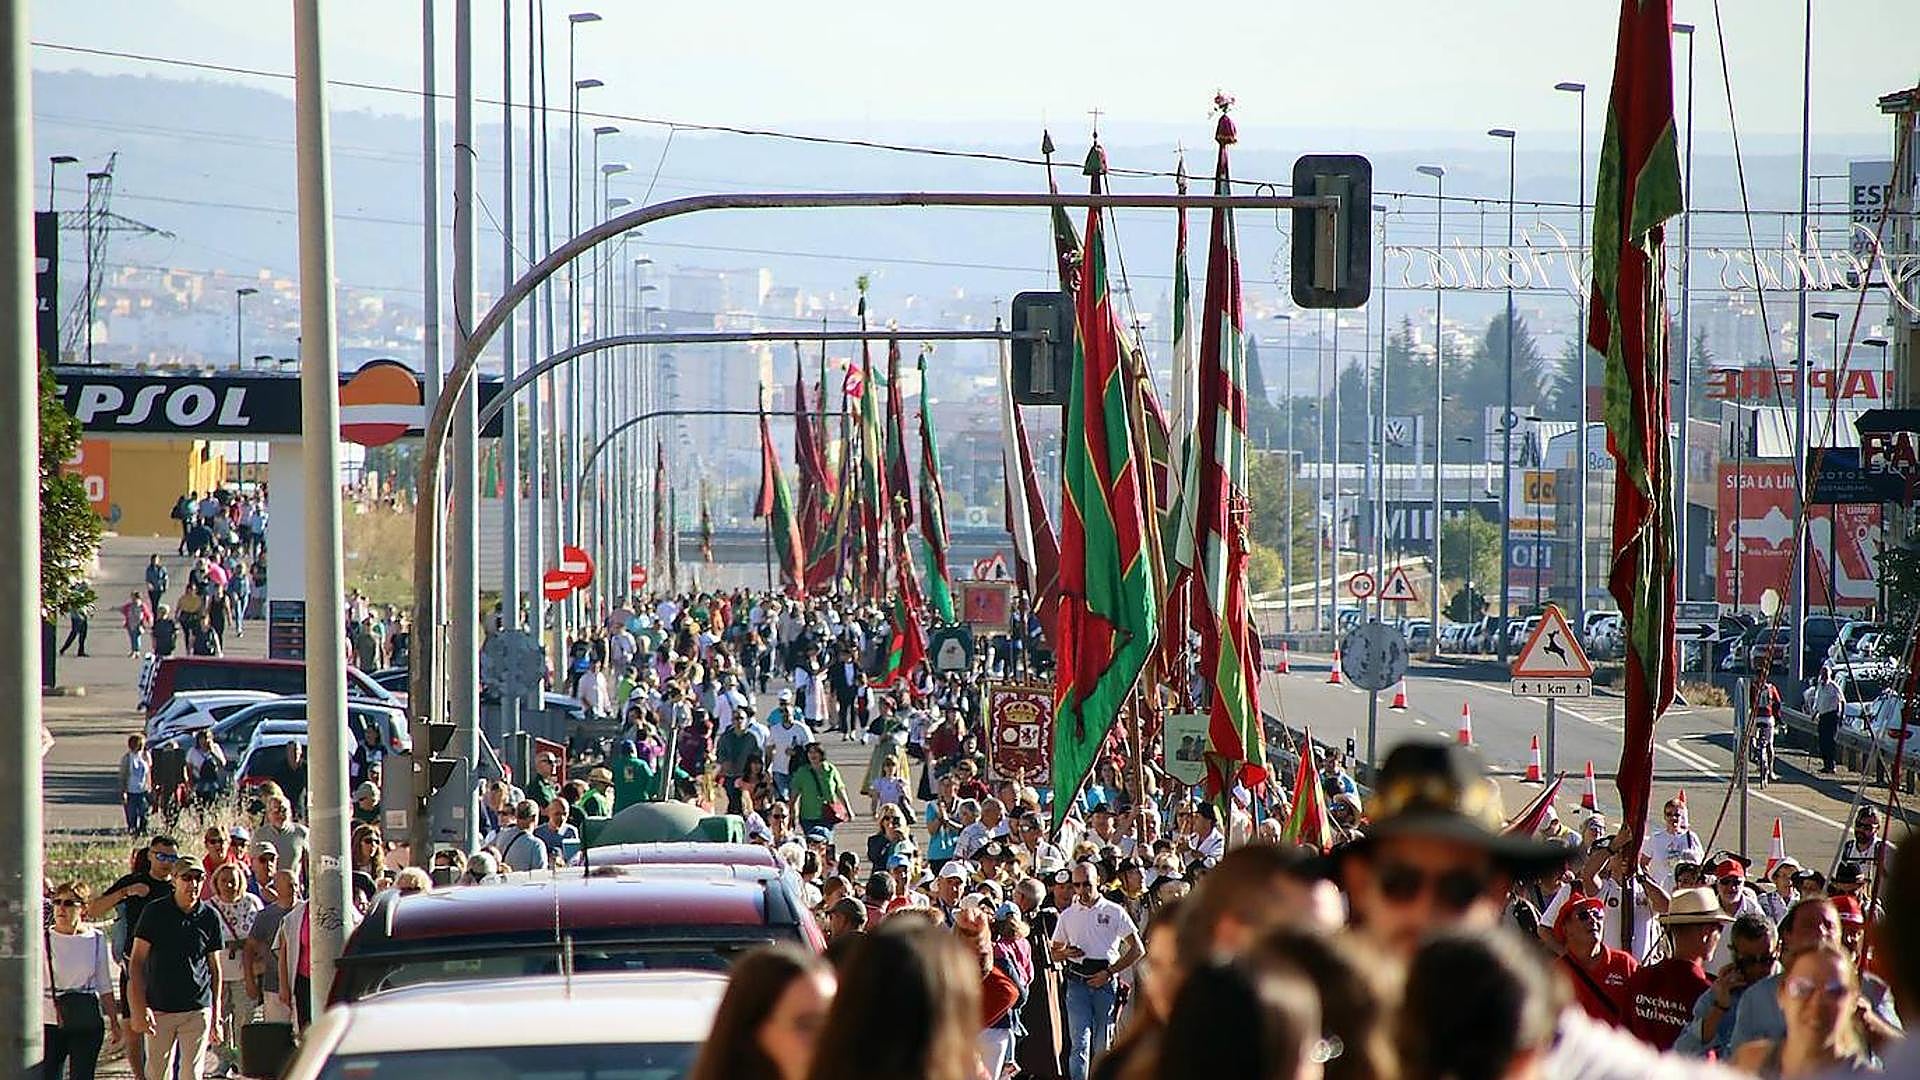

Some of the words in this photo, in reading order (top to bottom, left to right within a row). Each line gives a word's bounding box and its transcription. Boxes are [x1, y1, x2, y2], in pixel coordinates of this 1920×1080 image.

[1758, 474, 1773, 489] LA
[1536, 682, 1541, 693] 1
[1547, 682, 1566, 694] km
